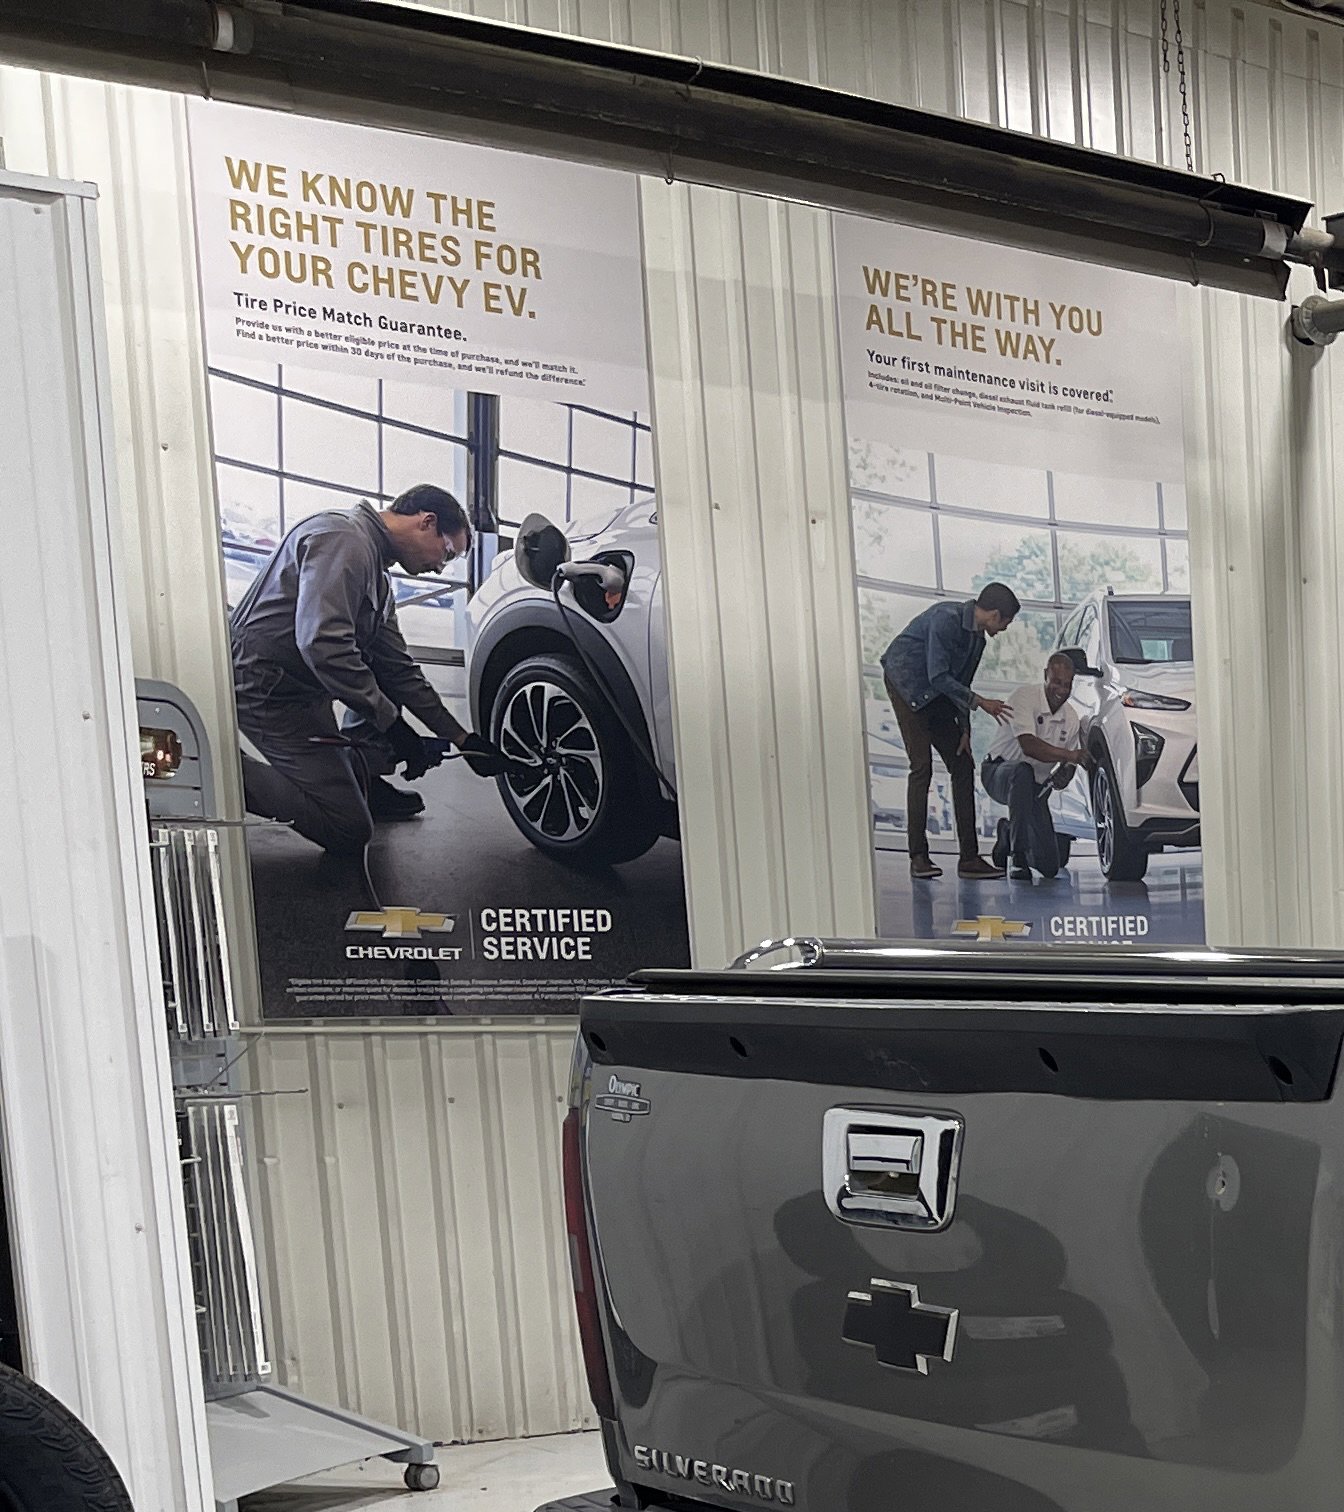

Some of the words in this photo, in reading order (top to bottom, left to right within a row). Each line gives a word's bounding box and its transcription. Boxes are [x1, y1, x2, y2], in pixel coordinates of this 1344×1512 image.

[224, 155, 288, 198] WE
[301, 170, 415, 219] KNOW
[426, 191, 496, 233] THE
[229, 199, 344, 248] RIGHT
[355, 221, 461, 267] TIRES
[474, 239, 543, 281] FOR
[229, 240, 335, 289] YOUR
[347, 261, 471, 309] CHEVY
[483, 282, 537, 320] EV.
[862, 265, 958, 312] WE'RE
[966, 286, 1041, 327] WITH
[1048, 301, 1103, 337] YOU
[233, 292, 267, 311] Tire
[273, 299, 316, 319] Price
[322, 307, 372, 327] Match
[378, 316, 467, 341] Guarantee.
[866, 303, 922, 342] ALL
[930, 316, 987, 354] THE
[995, 327, 1062, 366] WAY.
[235, 317, 269, 330] Provide
[284, 326, 304, 335] with
[314, 330, 342, 341] better
[377, 341, 399, 349] price
[413, 345, 427, 353] the
[429, 348, 448, 357] time
[541, 364, 567, 372] match
[236, 329, 255, 339] Find
[265, 334, 294, 345] better
[296, 340, 318, 349] price
[320, 344, 348, 353] within
[350, 347, 362, 355] 30
[364, 349, 384, 360] days
[397, 354, 411, 363] the
[867, 349, 897, 366] Your
[901, 356, 930, 374] first
[934, 366, 1016, 388] maintenance
[1019, 378, 1045, 393] visit
[1048, 382, 1058, 395] is
[480, 907, 613, 933] CERTIFIED
[1050, 915, 1149, 937] CERTIFIED
[345, 946, 463, 960] CHEVROLET
[483, 936, 593, 961] SERVICE
[634, 1445, 796, 1504] SILVERADO
